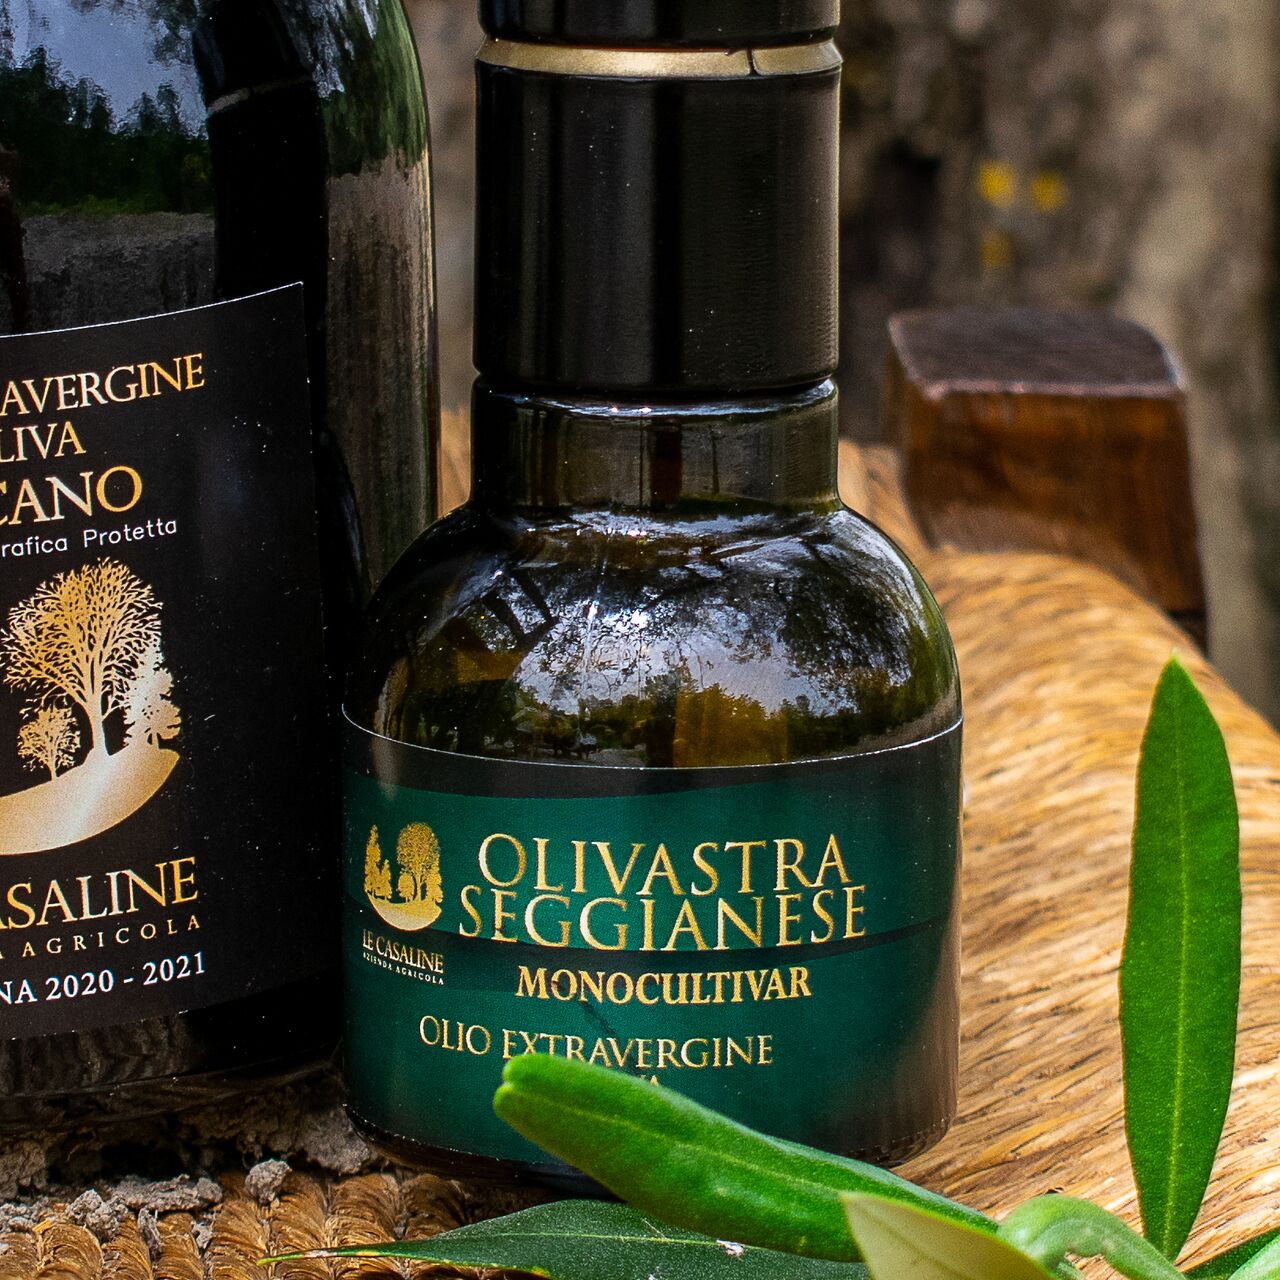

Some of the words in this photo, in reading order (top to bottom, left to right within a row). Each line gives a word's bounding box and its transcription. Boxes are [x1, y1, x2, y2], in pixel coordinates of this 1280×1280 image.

[83, 517, 178, 550] Protetta
[477, 833, 852, 896] OLIVASTRA
[21, 914, 201, 958] AGRICOLA
[459, 884, 867, 952] SEGGIANESE
[362, 928, 374, 951] LE
[376, 936, 444, 974] CASALINE
[45, 968, 115, 1002] 2020
[142, 951, 206, 987] 2021
[515, 965, 813, 1006] MONOCULTIVAR
[419, 1015, 492, 1057] OLIO
[502, 1028, 773, 1069] EXTRAVERGINE
